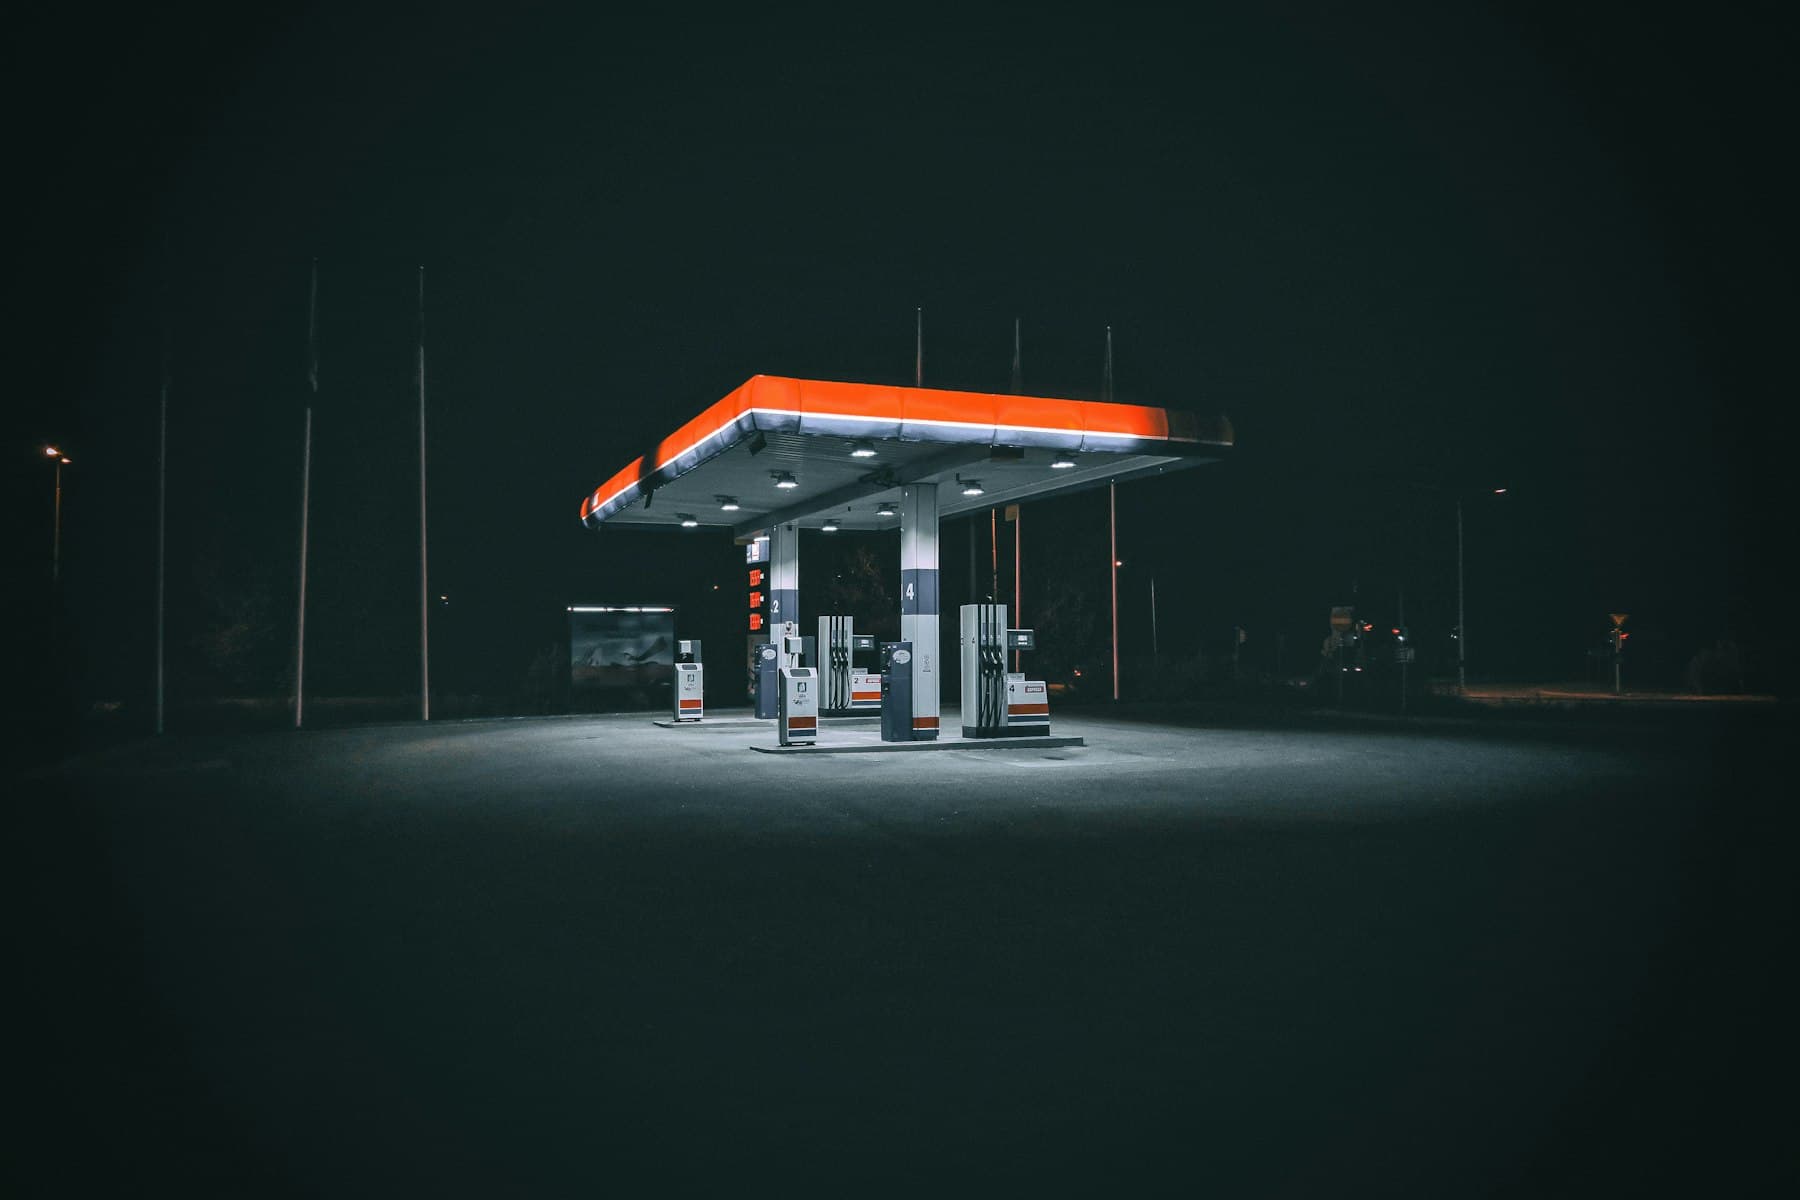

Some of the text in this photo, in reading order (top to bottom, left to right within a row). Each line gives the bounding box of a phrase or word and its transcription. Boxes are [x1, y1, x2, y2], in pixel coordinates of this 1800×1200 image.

[906, 583, 915, 600] 4
[773, 599, 779, 613] 2
[1009, 684, 1015, 692] 4
